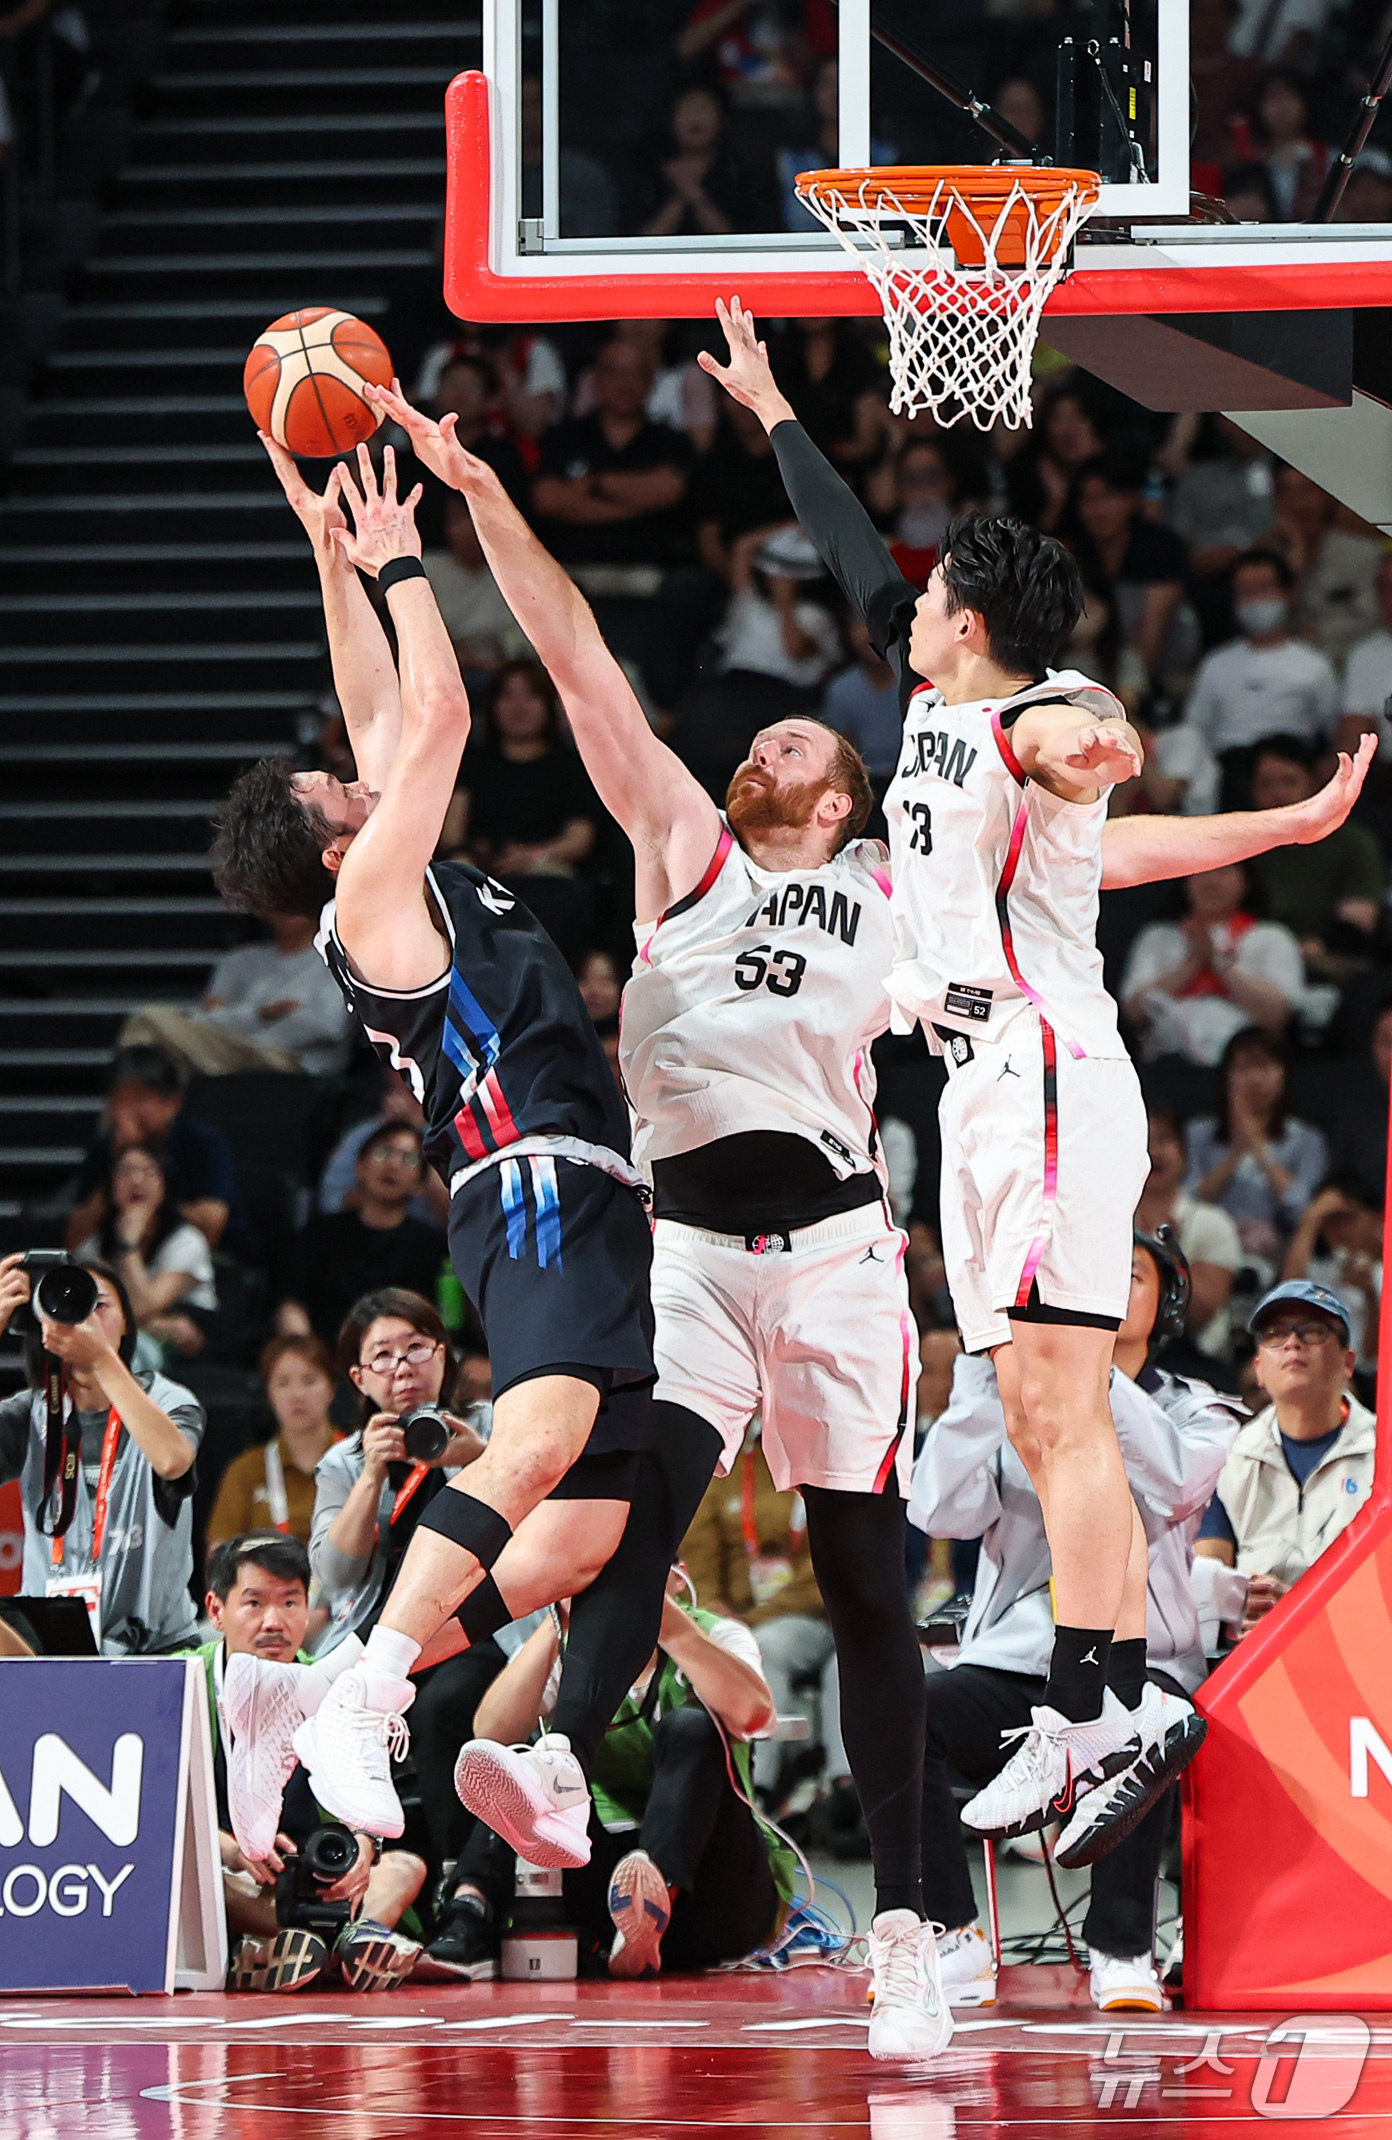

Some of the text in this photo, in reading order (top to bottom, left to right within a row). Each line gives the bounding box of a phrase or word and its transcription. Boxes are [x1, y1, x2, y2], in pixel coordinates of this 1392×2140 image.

[735, 945, 807, 998] 53
[973, 1005, 986, 1017] 52
[65, 1452, 76, 1481] EOS
[0, 1732, 144, 1848] N
[0, 1863, 136, 1918] OGY
